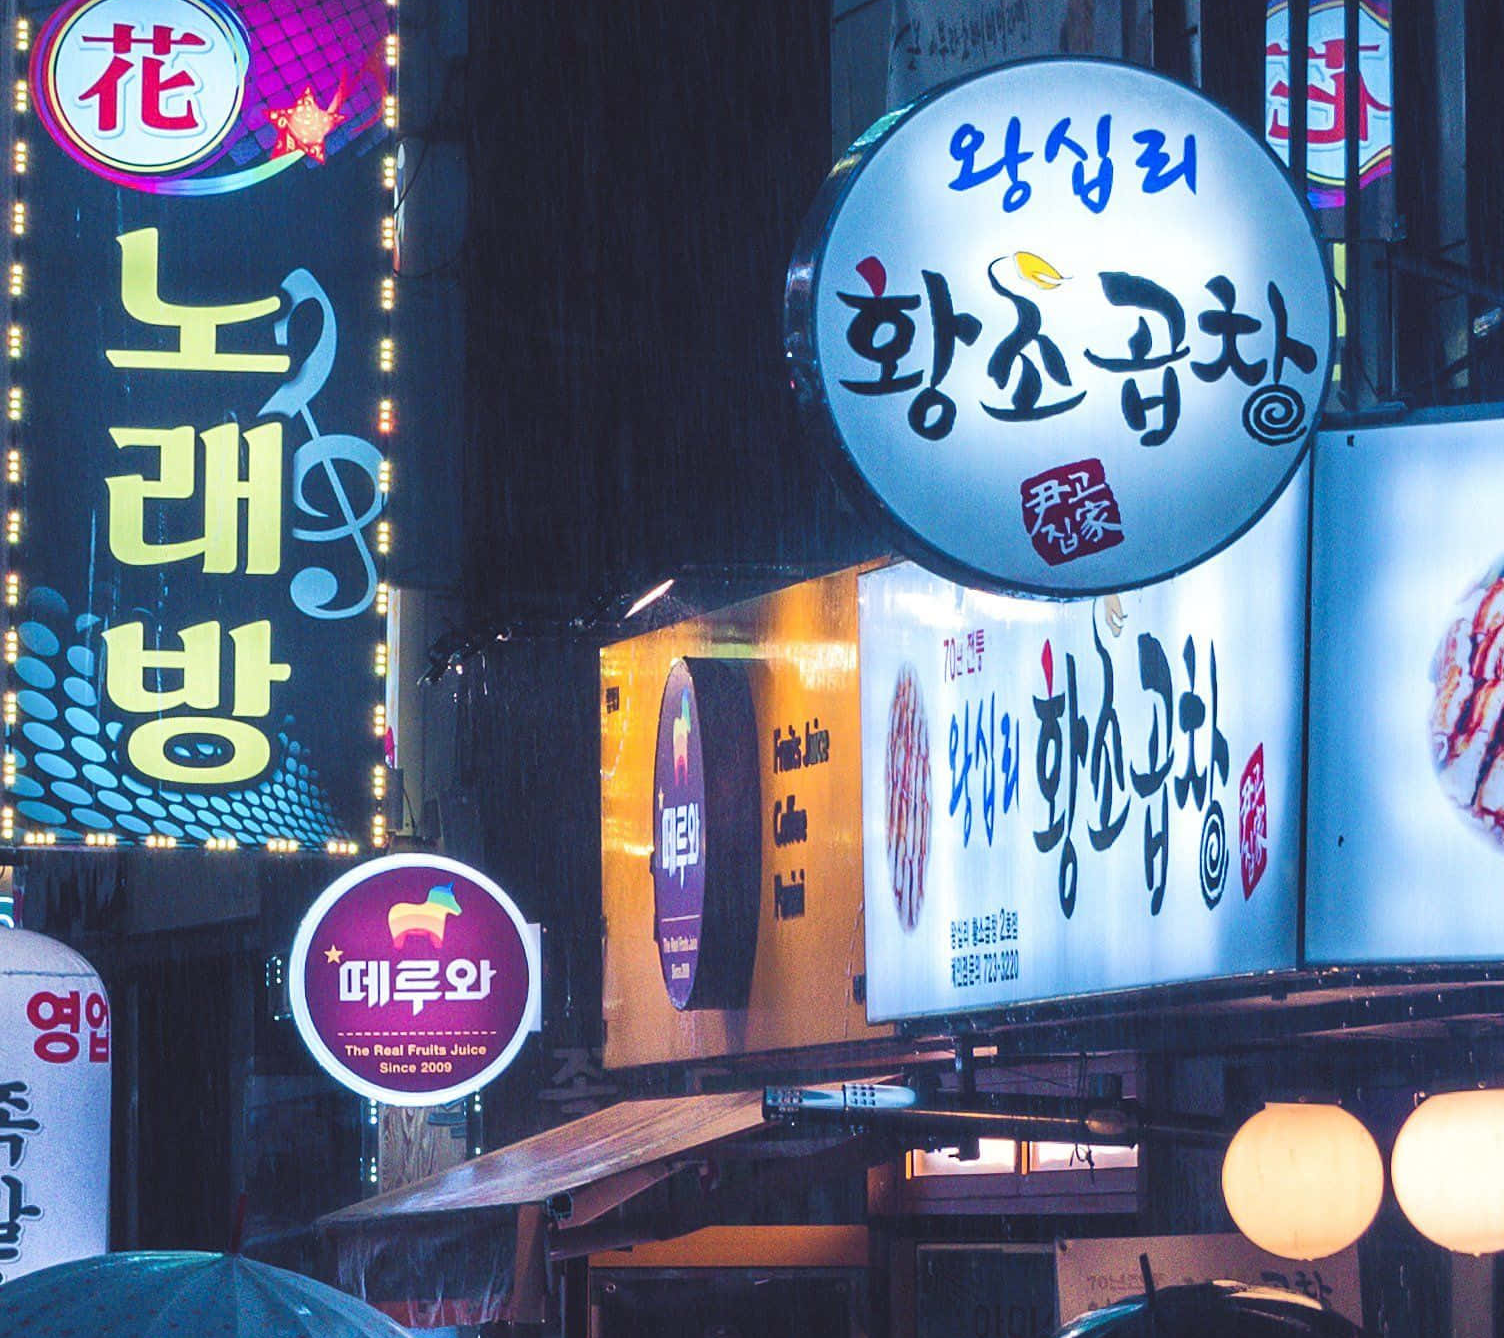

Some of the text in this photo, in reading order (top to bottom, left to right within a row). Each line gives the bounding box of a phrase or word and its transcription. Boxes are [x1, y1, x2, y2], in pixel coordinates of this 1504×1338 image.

[78, 23, 208, 139] 花
[948, 113, 1197, 214] 왕십리
[837, 254, 1317, 446] 황소곱창
[104, 226, 293, 786] 노래방
[949, 692, 1021, 849] 왕십리
[1033, 621, 1231, 920] 황소곱창
[339, 959, 497, 1016] 떼루와
[983, 948, 1019, 984] 723-3220
[344, 1043, 488, 1059] The Real Fruits Juice
[378, 1061, 453, 1075] Since 2009
